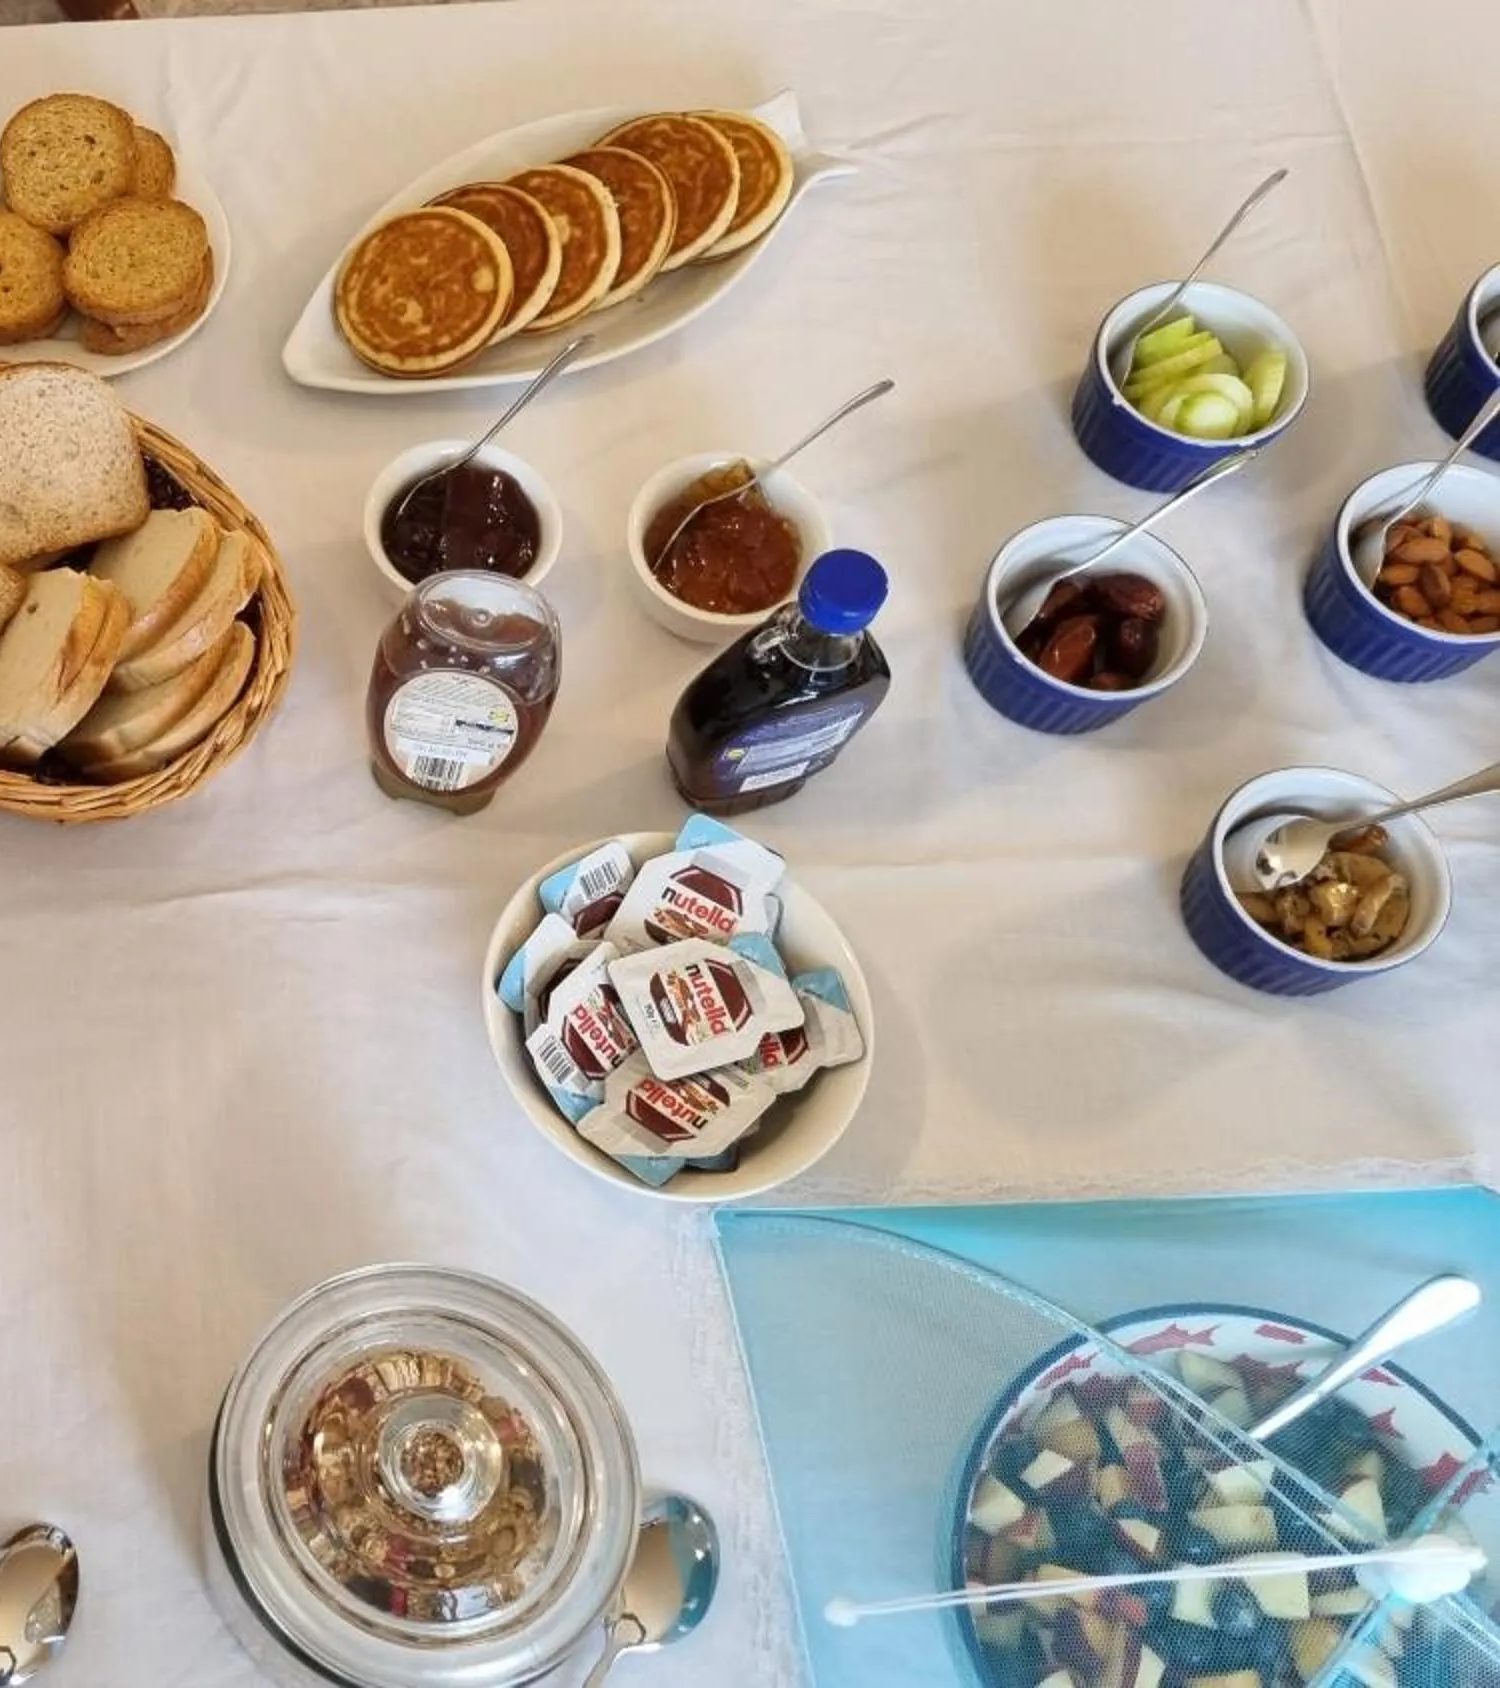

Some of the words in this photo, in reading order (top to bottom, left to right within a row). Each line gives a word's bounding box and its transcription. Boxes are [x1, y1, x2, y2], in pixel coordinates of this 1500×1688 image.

[661, 886, 738, 933] nutella
[685, 964, 731, 1035] nutella
[570, 1004, 624, 1068] nutella
[633, 1079, 708, 1129] nutella
